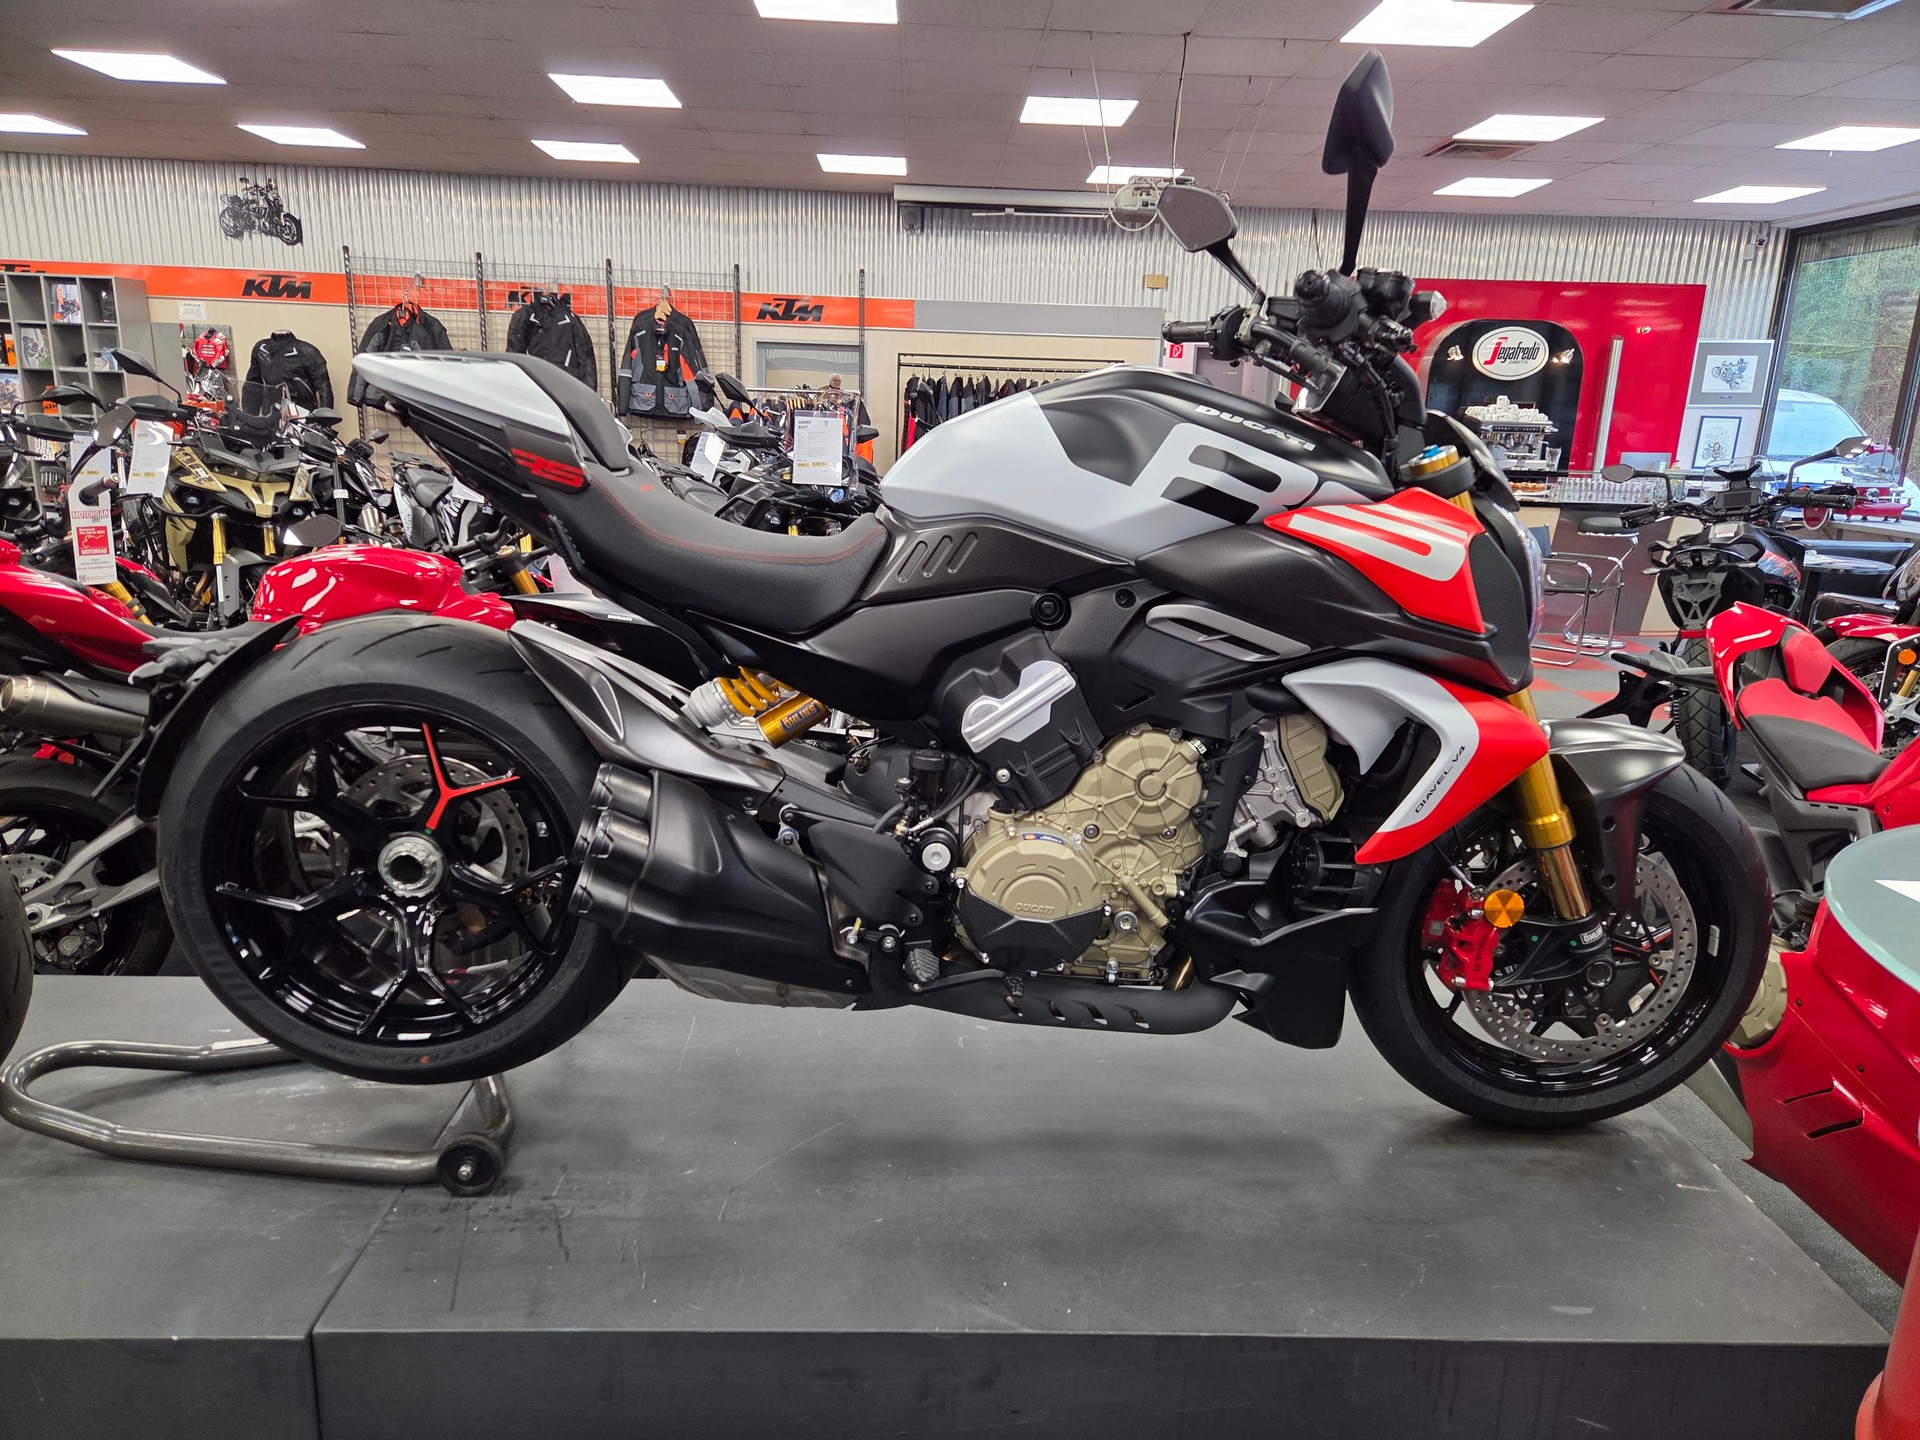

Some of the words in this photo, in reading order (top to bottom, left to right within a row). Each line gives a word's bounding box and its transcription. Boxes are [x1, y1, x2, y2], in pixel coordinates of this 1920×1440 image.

[242, 274, 312, 299] KTM
[756, 298, 824, 322] KTM
[1194, 404, 1317, 452] DUCATI
[72, 509, 110, 520] MOTORRAD
[782, 703, 817, 728] ÖHLINS
[1414, 765, 1454, 814] DIAVEL
[1451, 745, 1466, 763] V4
[1014, 902, 1055, 916] DUCATI
[1472, 933, 1489, 972] brembo
